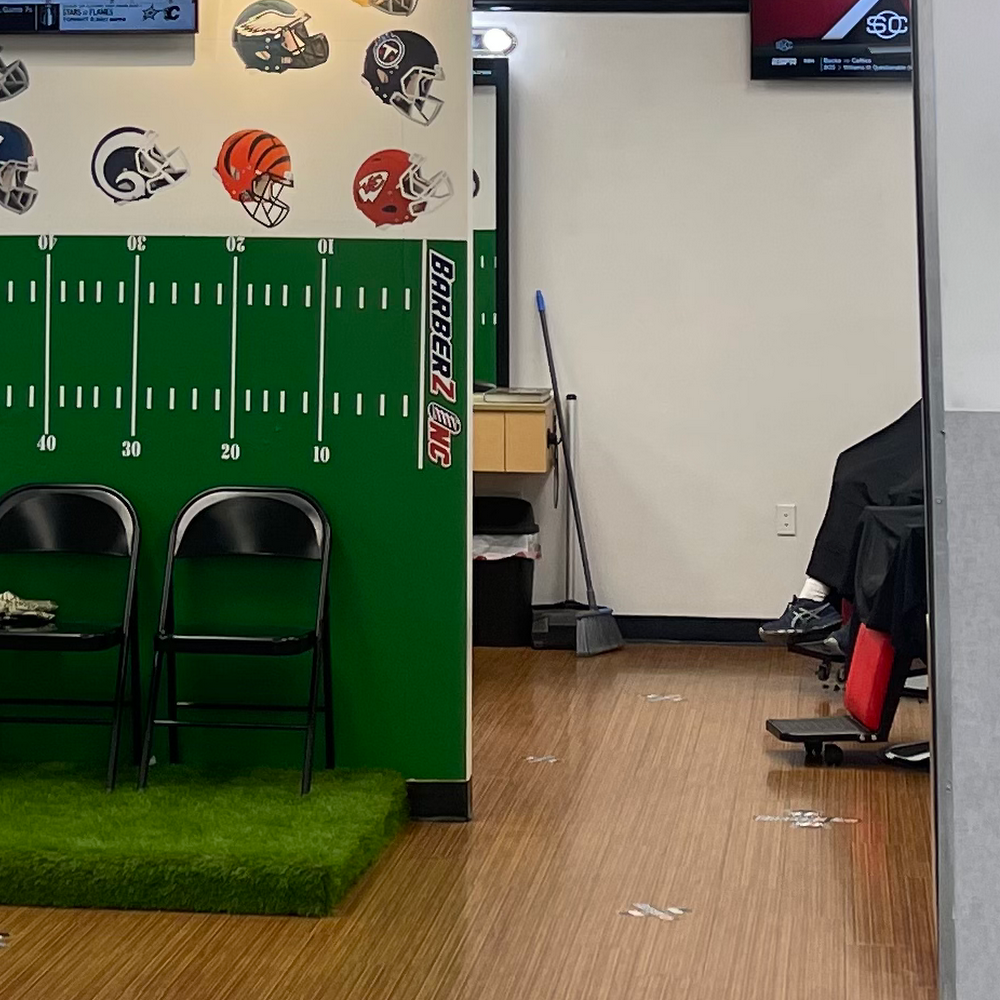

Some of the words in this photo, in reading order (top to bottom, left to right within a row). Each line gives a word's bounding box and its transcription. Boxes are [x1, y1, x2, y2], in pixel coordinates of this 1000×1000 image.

[430, 250, 456, 402] BARBERZ
[36, 434, 57, 451] 40
[121, 440, 141, 458] 30
[220, 443, 241, 461] 20
[313, 445, 330, 463] 10
